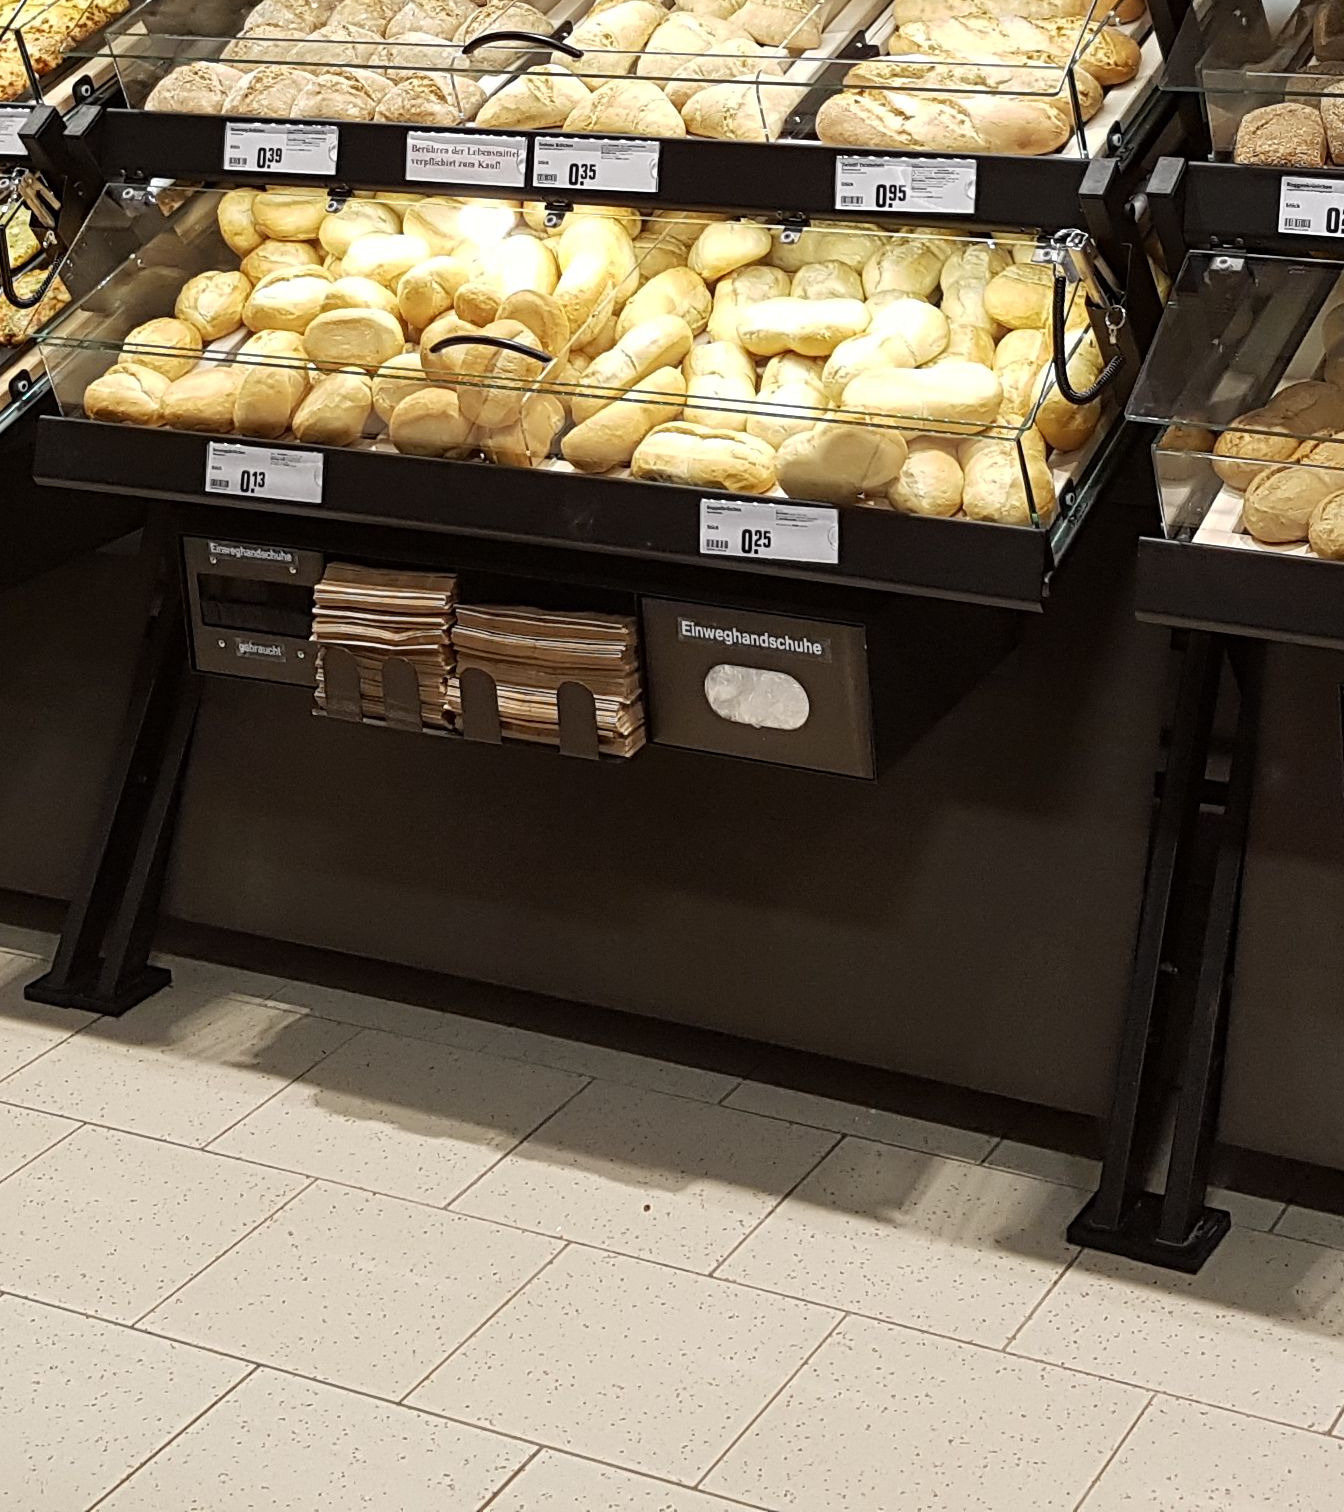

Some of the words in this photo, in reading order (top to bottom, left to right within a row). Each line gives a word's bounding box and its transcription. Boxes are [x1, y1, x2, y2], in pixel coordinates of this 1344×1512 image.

[256, 147, 283, 169] 0.39
[568, 163, 596, 186] 0.35
[875, 184, 907, 208] 0.95
[240, 470, 266, 494] 0.13
[210, 543, 293, 562] Einweghandschuhe
[741, 529, 772, 555] 0.25
[681, 620, 822, 655] Einweghandschuhe
[238, 642, 282, 657] gebraucht
